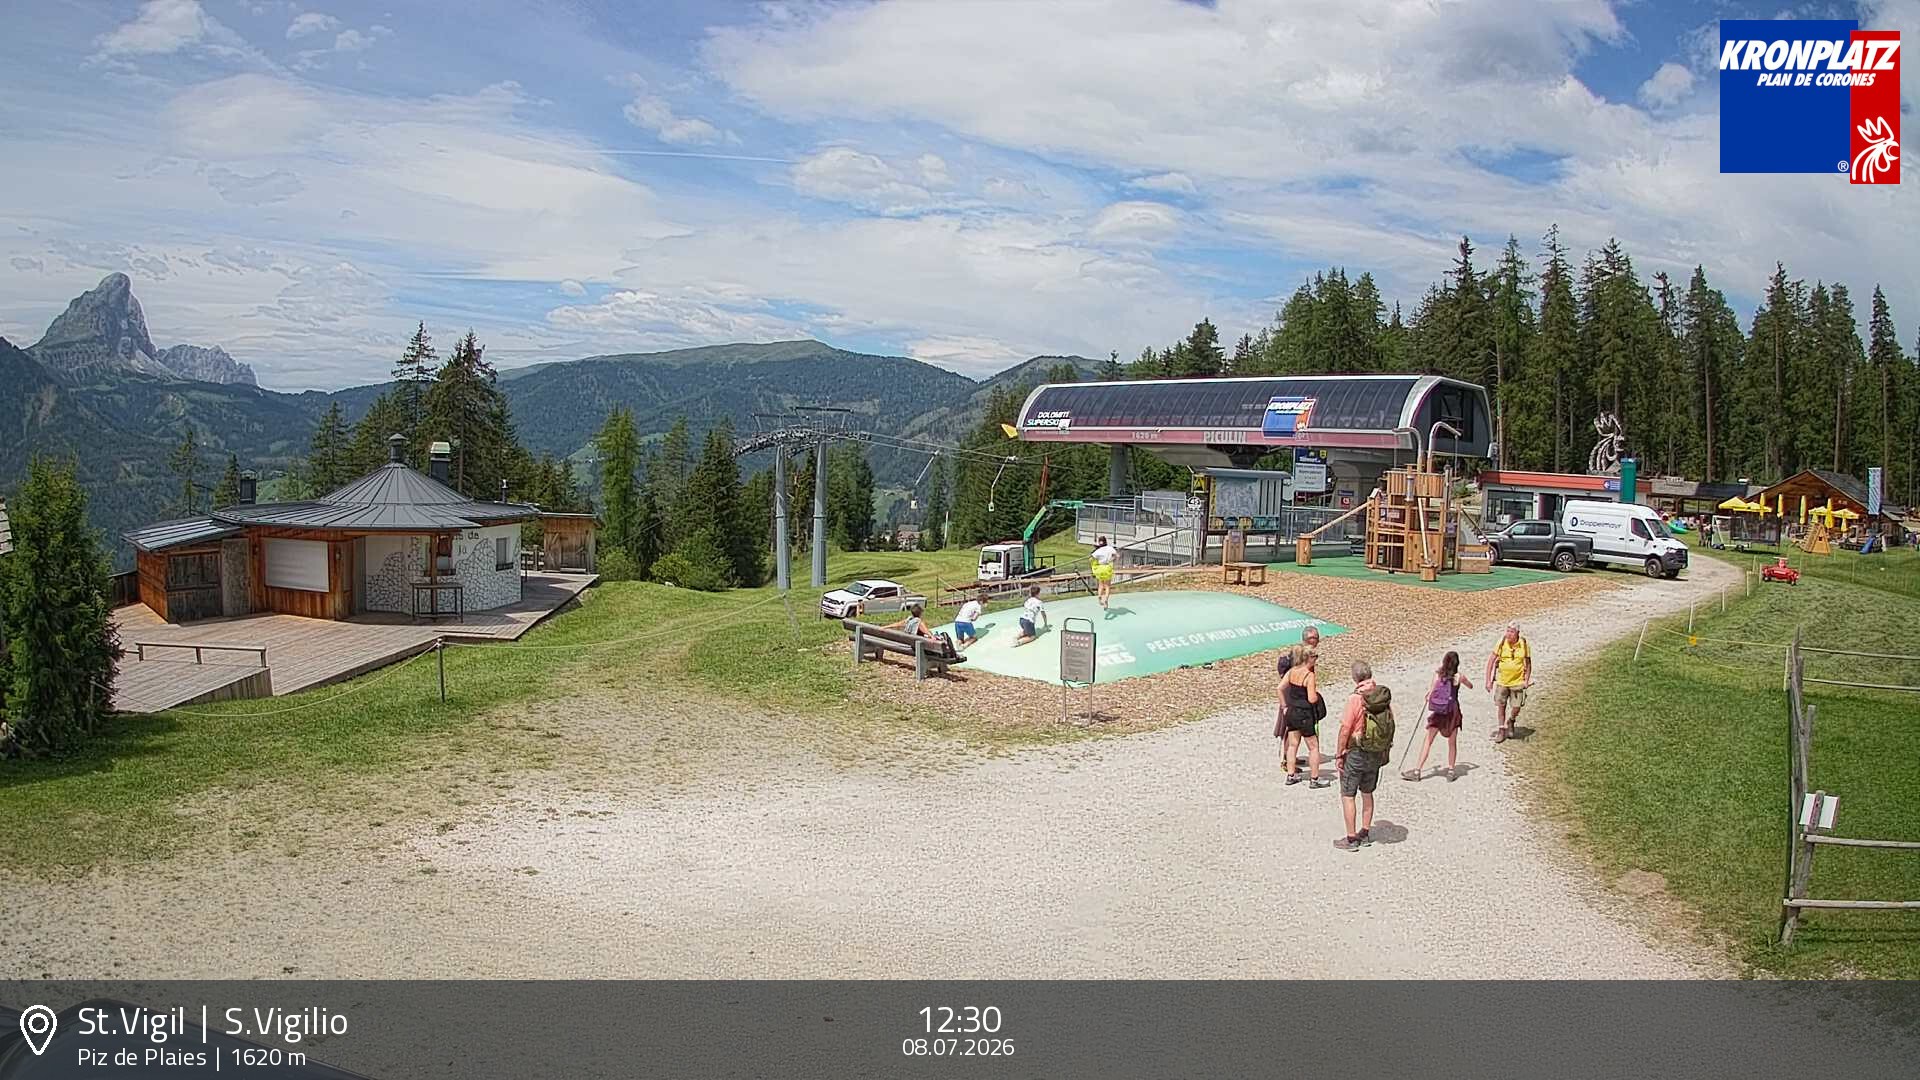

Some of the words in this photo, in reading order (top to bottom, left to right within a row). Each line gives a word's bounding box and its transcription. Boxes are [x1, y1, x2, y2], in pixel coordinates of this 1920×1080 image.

[1203, 431, 1247, 443] PICULIN
[1146, 636, 1190, 652] PEACE
[1188, 632, 1206, 644] OF
[1205, 627, 1237, 642] MIND
[1249, 623, 1271, 634] ALL
